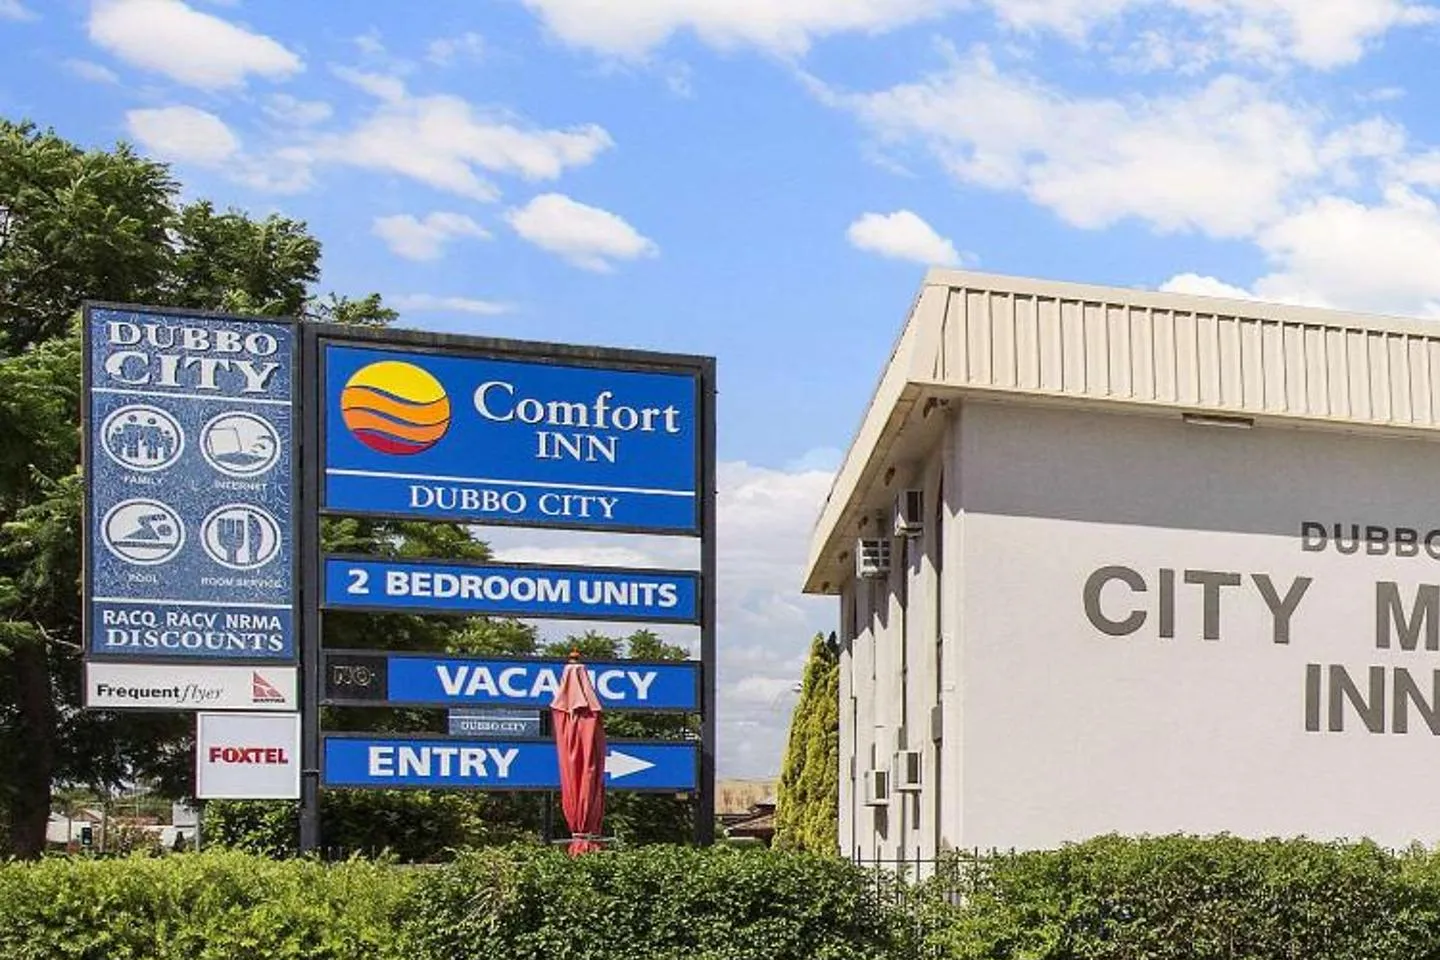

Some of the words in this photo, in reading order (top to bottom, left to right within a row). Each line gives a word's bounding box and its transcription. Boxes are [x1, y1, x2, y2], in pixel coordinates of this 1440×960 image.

[108, 321, 278, 356] DUBBO
[105, 351, 279, 393] CITY
[473, 381, 680, 433] Comfort
[536, 431, 619, 463] INN
[410, 485, 527, 513] DUBBO
[539, 494, 619, 519] CITY
[347, 570, 370, 594] 2
[387, 572, 570, 603] BEDROOM
[579, 581, 678, 608] UNITS
[1083, 565, 1313, 644] CITY
[103, 610, 157, 627] RACQ
[166, 612, 219, 628] RACV
[226, 613, 282, 631] NRMA
[105, 629, 283, 651] DISCOUNTS
[436, 665, 658, 700] VACACY
[209, 747, 289, 764] FOXTEL
[368, 746, 520, 779] ENTRY
